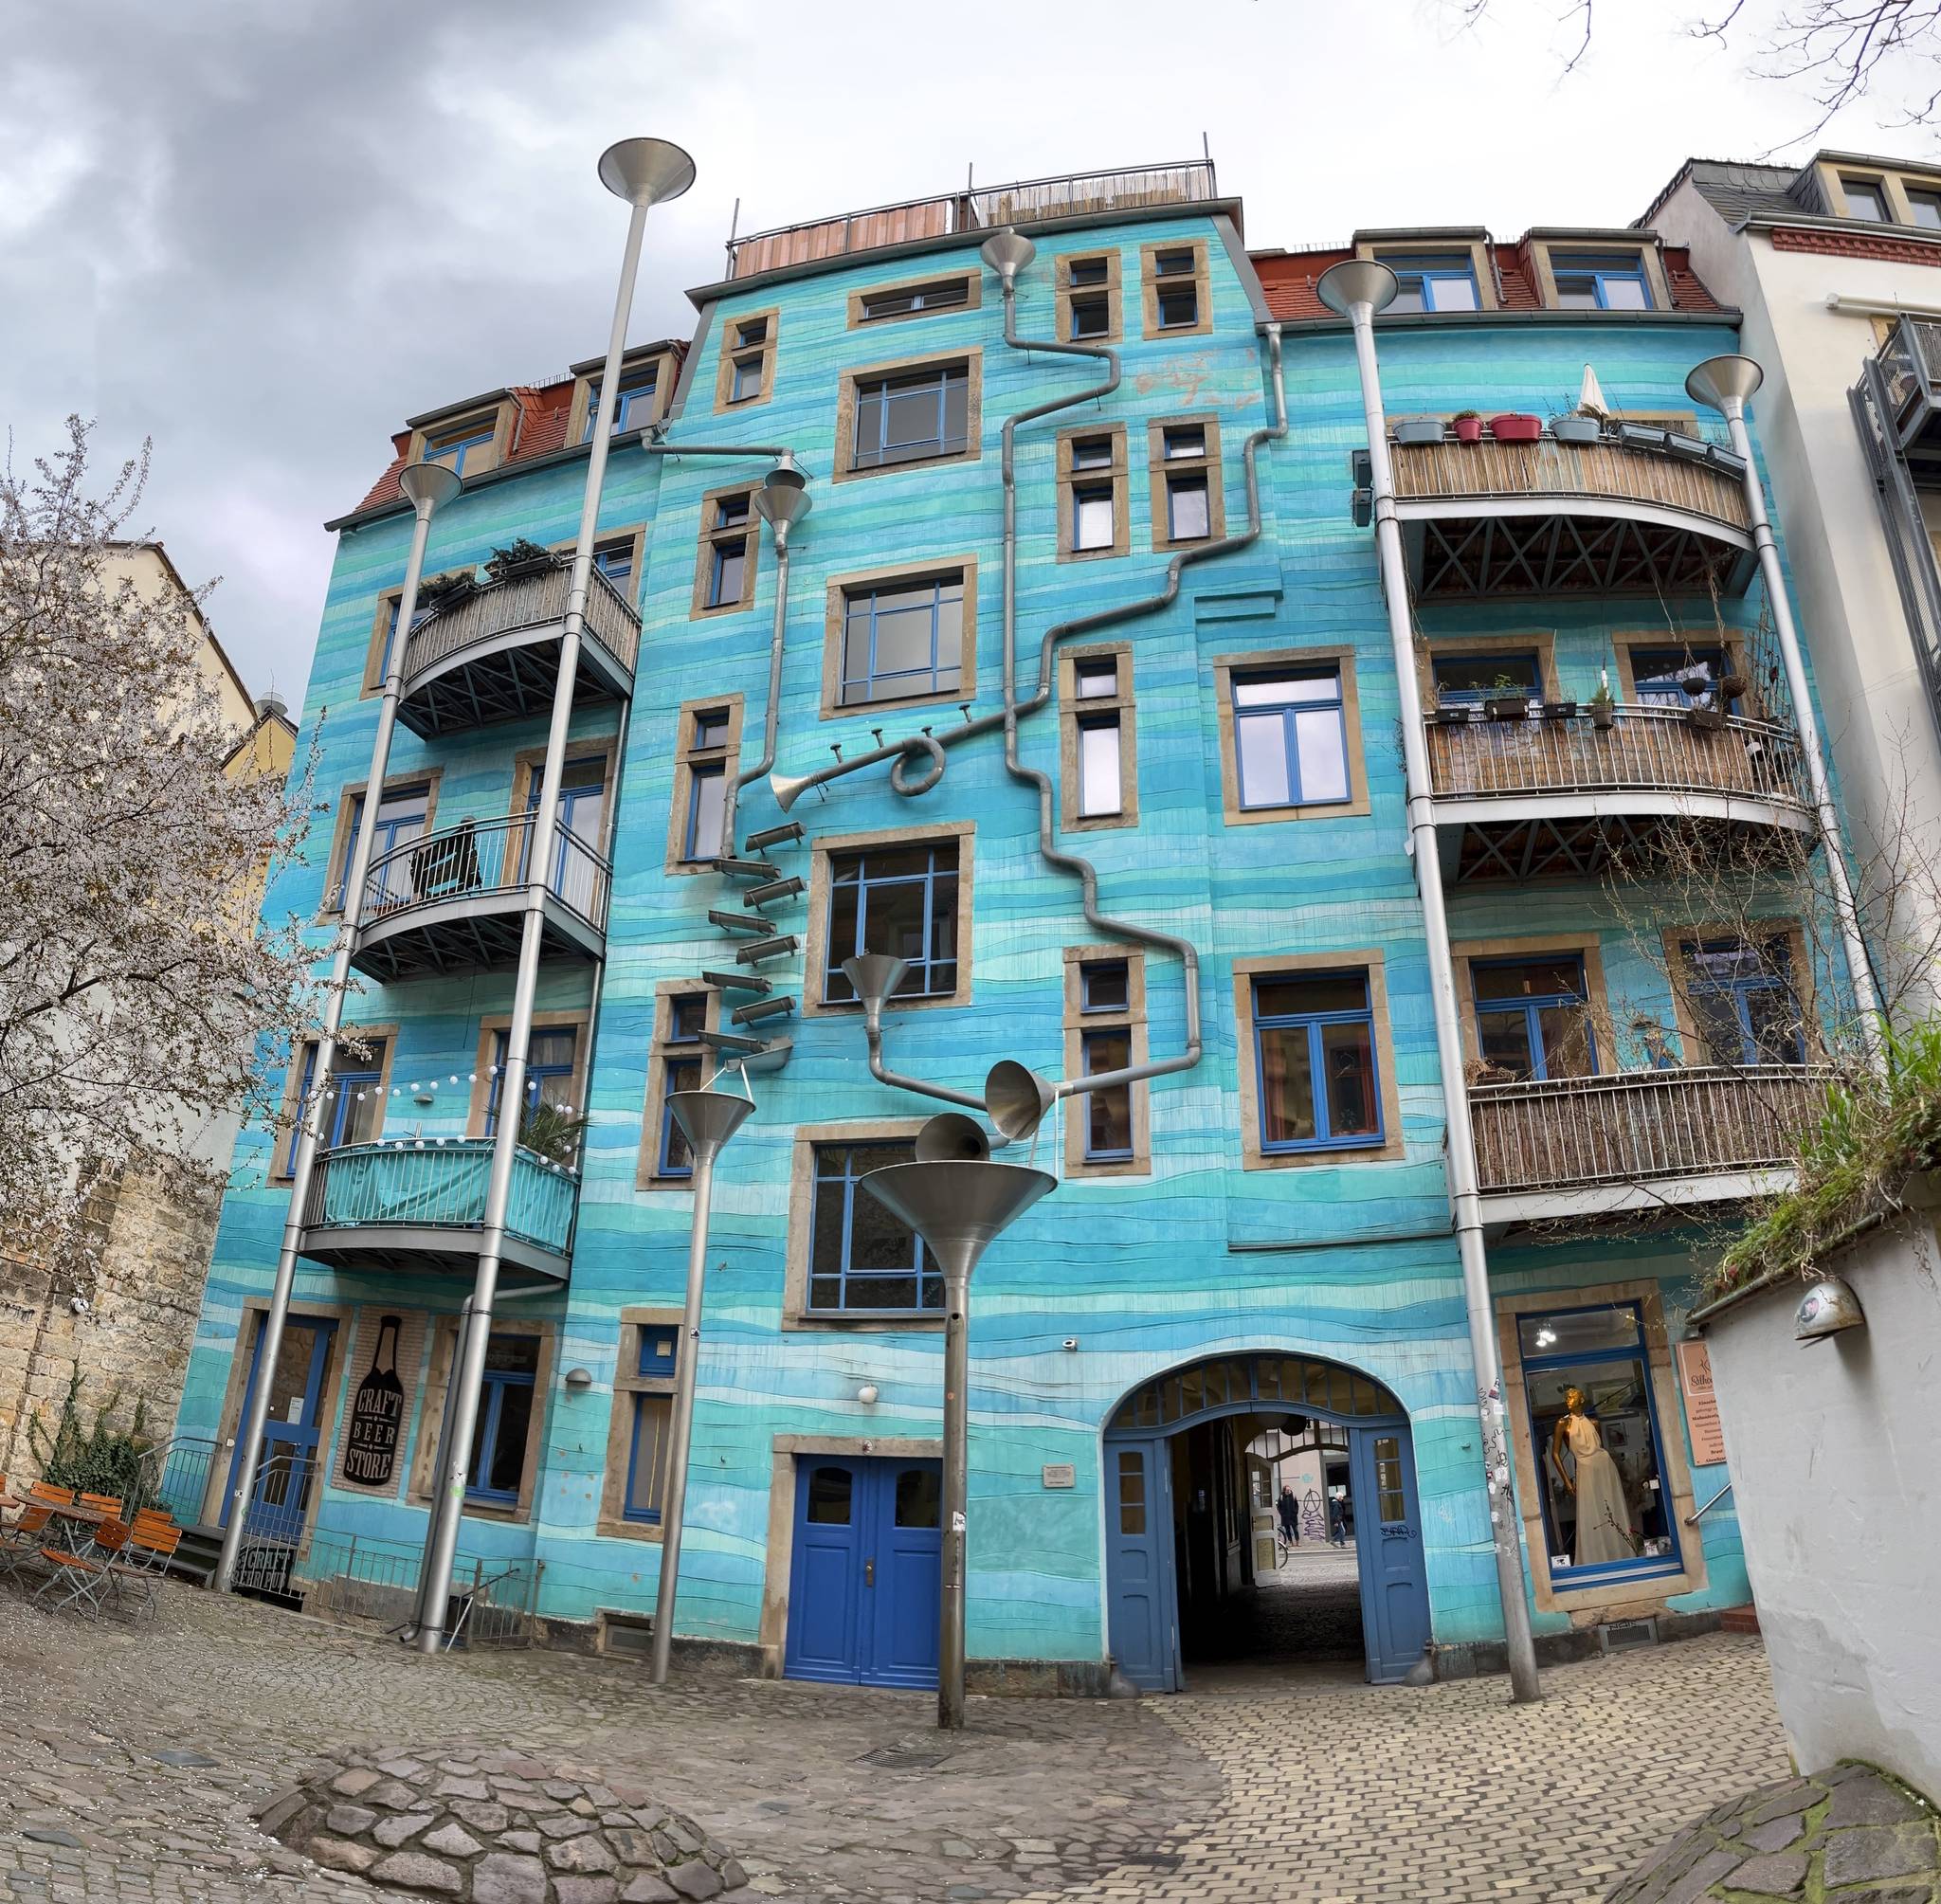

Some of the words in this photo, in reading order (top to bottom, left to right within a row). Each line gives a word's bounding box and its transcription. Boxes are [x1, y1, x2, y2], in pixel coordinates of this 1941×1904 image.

[357, 1388, 403, 1417] CRAFT
[353, 1422, 396, 1444] BEER
[346, 1448, 391, 1478] STORE
[247, 1550, 291, 1570] CRAFT
[263, 1571, 286, 1588] PUB
